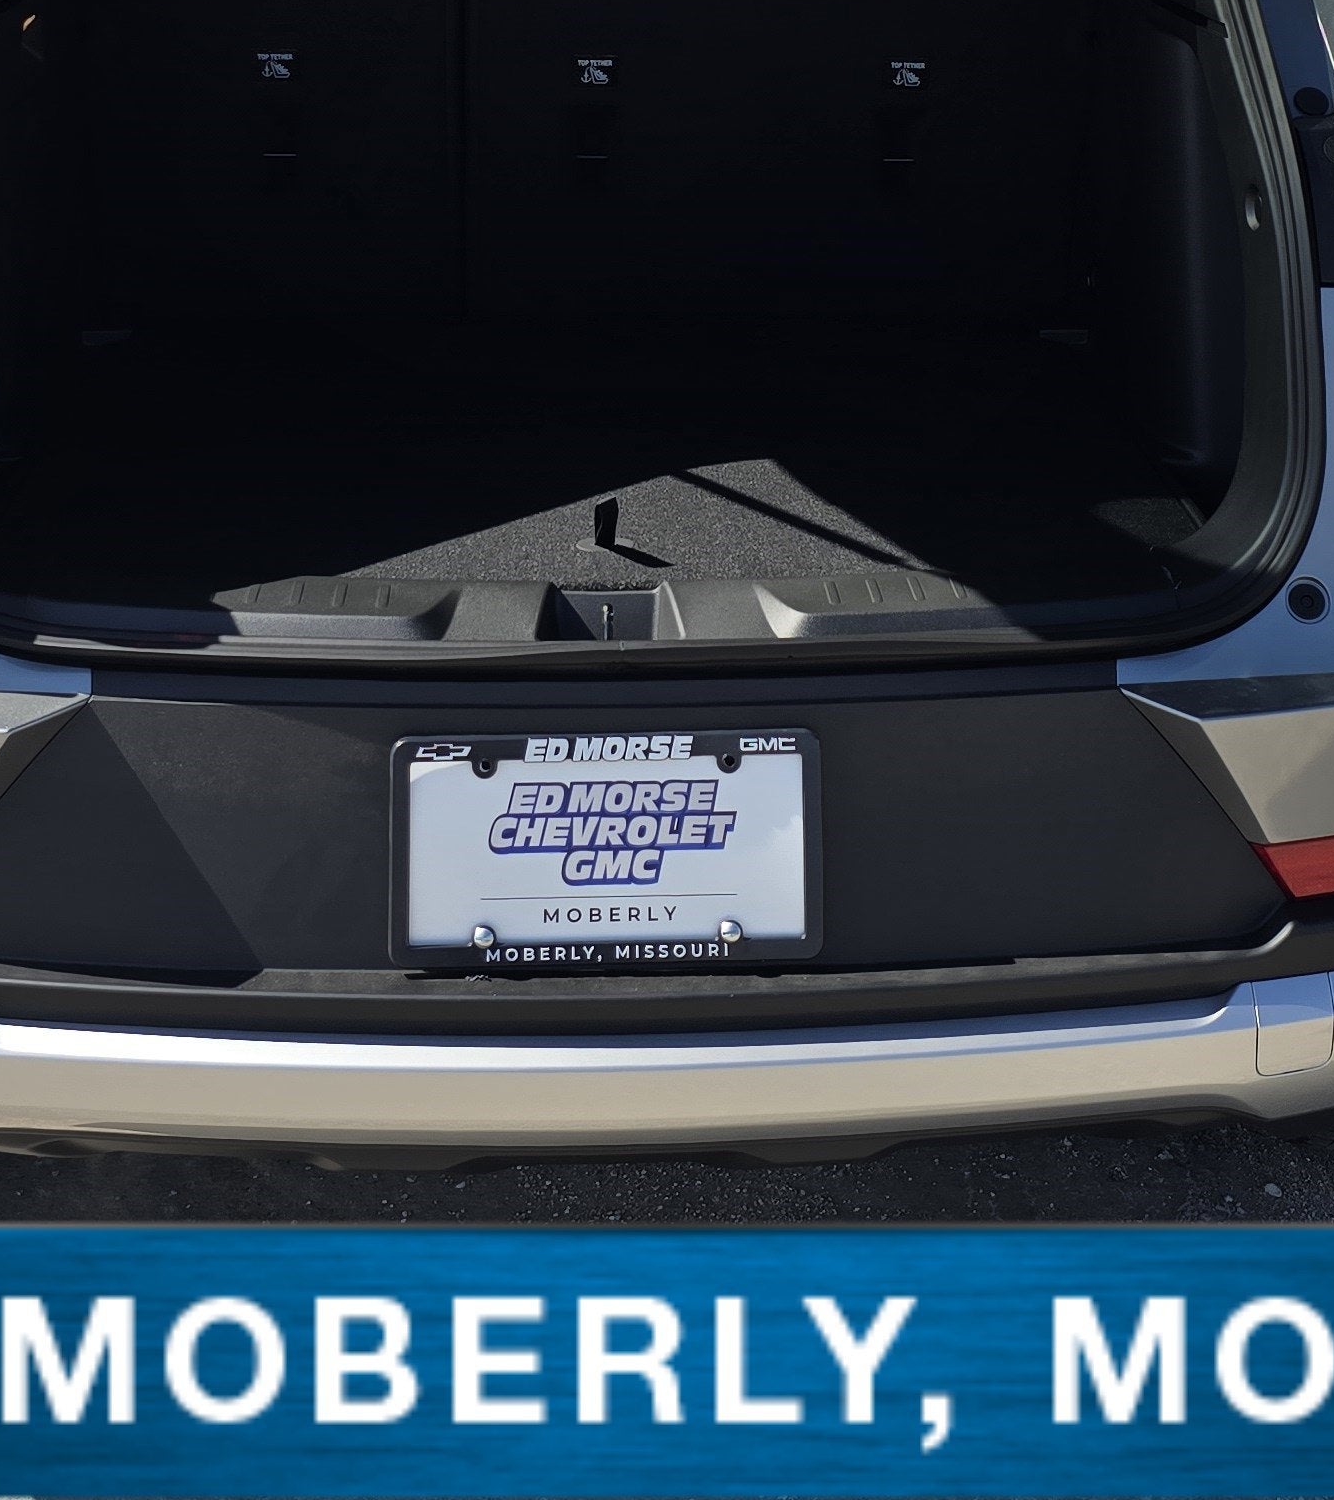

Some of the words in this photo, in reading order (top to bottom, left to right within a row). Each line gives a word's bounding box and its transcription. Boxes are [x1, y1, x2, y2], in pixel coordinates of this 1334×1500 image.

[523, 737, 569, 763] ED
[572, 735, 694, 762] MORSE
[739, 737, 796, 752] GMC
[508, 783, 566, 815] ED
[567, 781, 718, 814] MORSE
[489, 812, 736, 851] CHEVROLET
[563, 849, 663, 884] GMC
[543, 905, 677, 924] MOBERLY
[485, 945, 603, 963] MOBERLY,
[615, 942, 730, 960] MISSOURI
